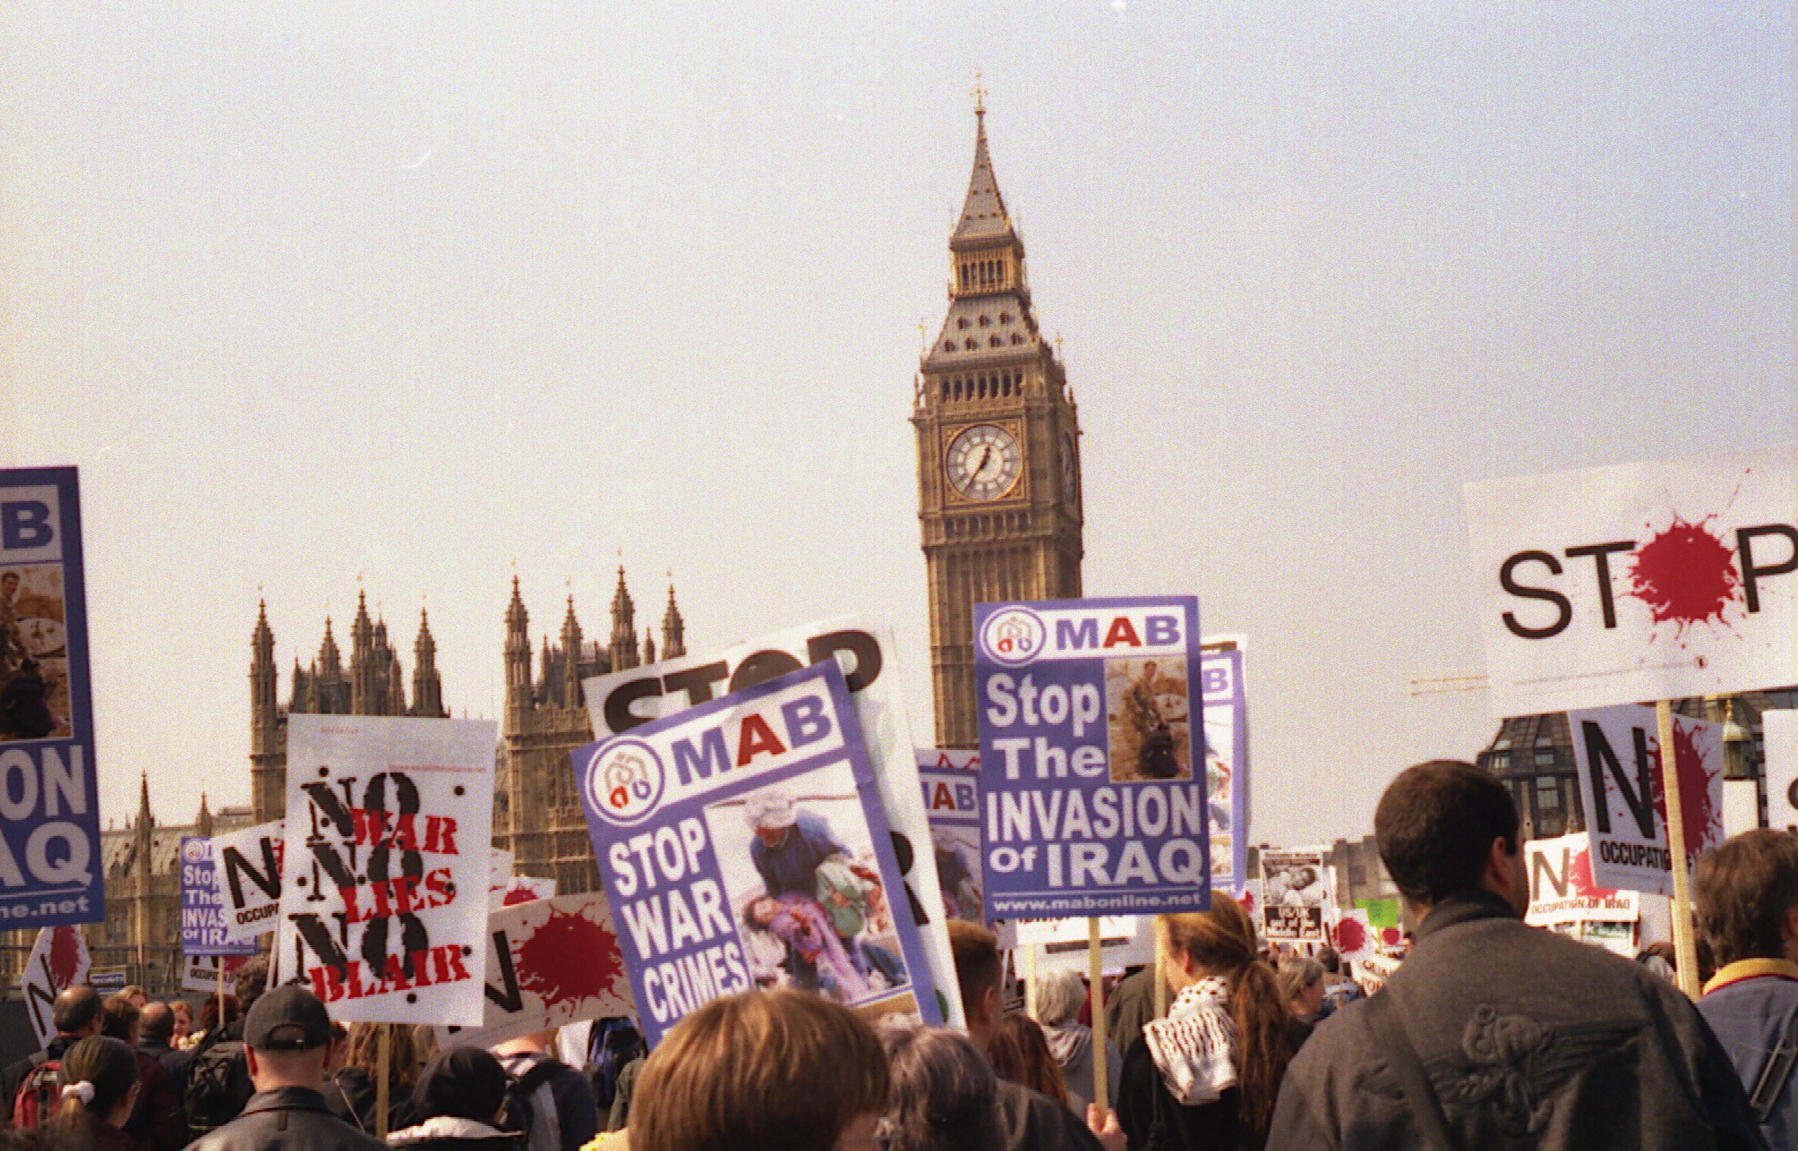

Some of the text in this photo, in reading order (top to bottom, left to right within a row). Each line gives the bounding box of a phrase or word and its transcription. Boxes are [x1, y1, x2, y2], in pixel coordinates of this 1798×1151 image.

[1500, 523, 1798, 640] STP
[1056, 615, 1181, 650] MAB
[986, 673, 1100, 737] Stop
[671, 695, 832, 786] MAB
[992, 737, 1106, 780] The
[301, 772, 421, 841] NO
[350, 808, 459, 855] WAR
[986, 784, 1201, 842] INVASION
[306, 838, 423, 902] NO
[609, 817, 706, 896] STOP
[1047, 838, 1204, 887] IRAQ
[338, 868, 457, 923] LIES
[621, 879, 733, 960] WAR
[992, 894, 1202, 912] www.mabonline.net
[285, 912, 429, 985] NO
[309, 944, 472, 1003] BLAIR
[644, 940, 749, 1023] CRIMES
